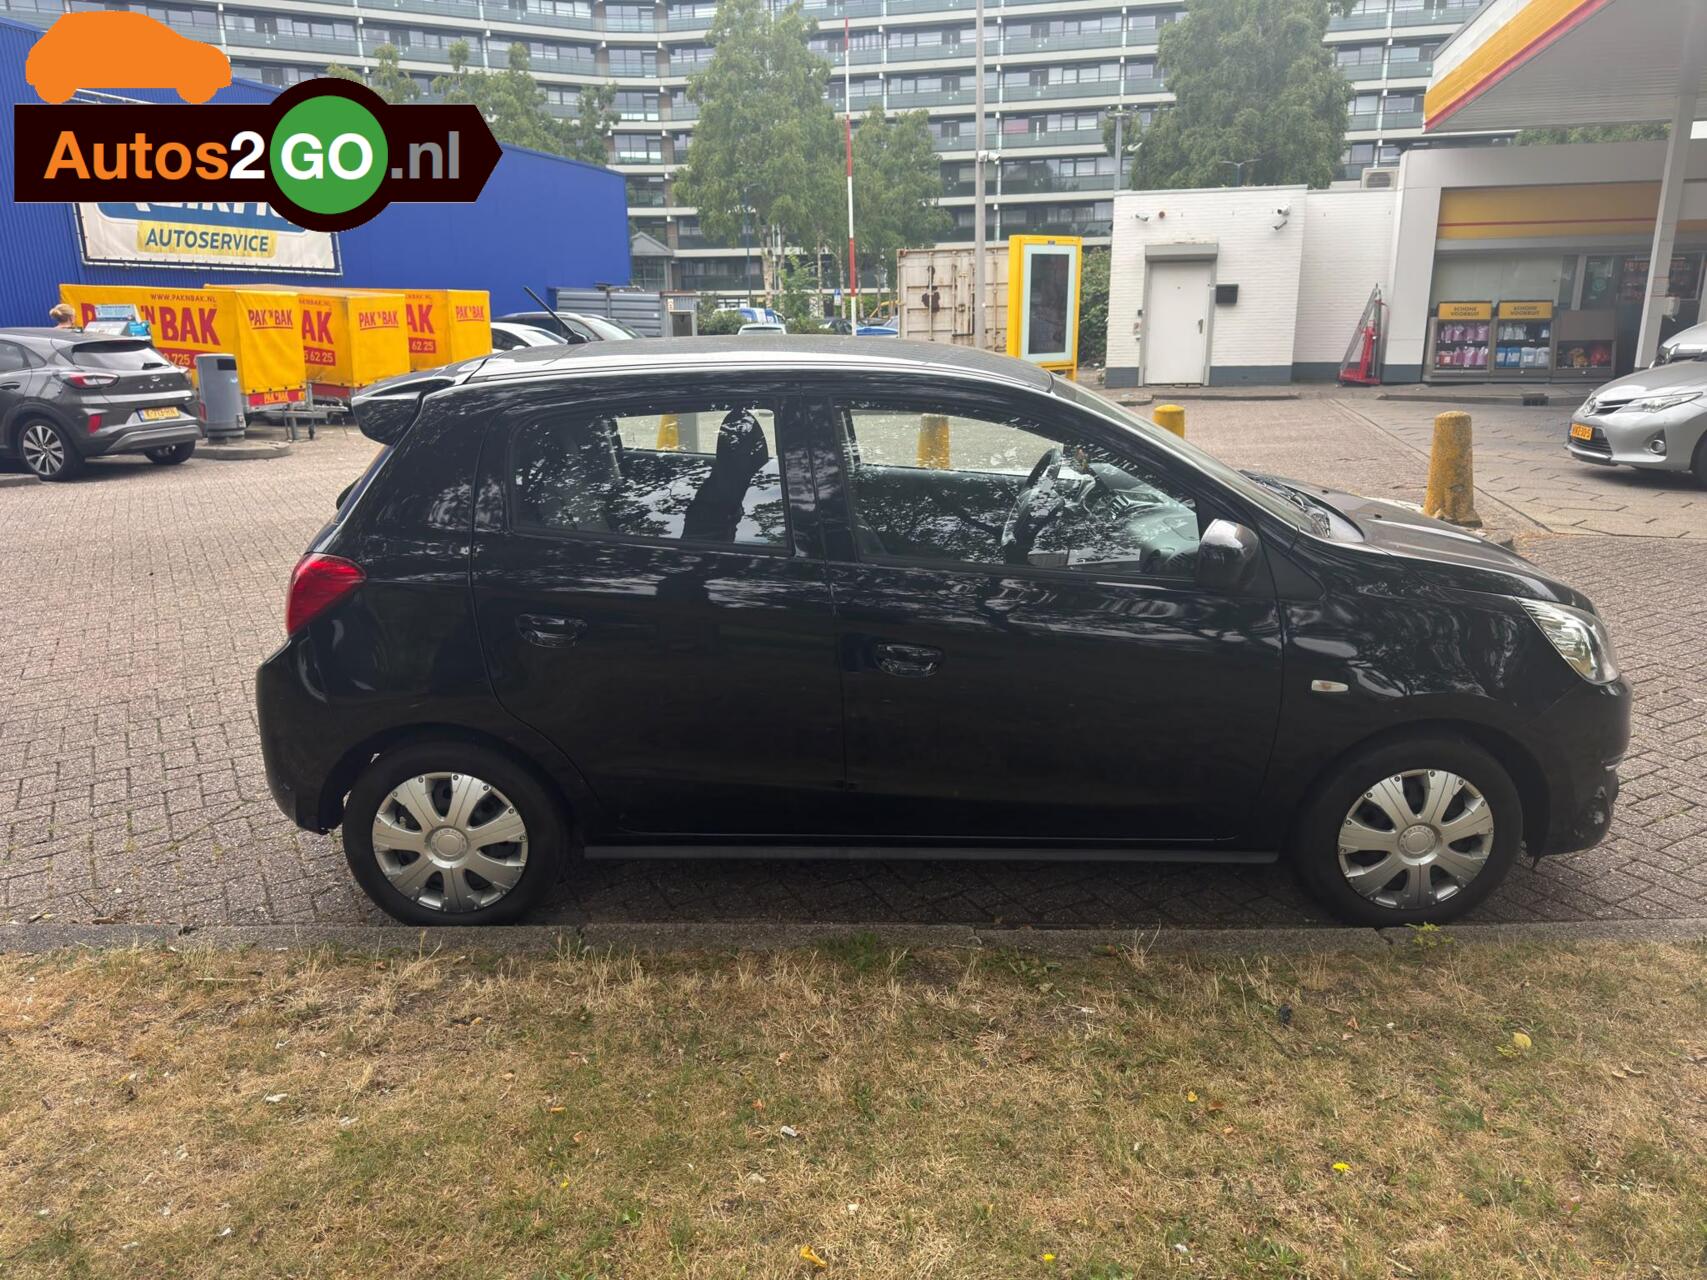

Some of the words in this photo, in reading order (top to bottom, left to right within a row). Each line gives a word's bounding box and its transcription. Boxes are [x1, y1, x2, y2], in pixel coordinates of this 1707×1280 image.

[145, 228, 269, 252] AUTOSERVICE
[159, 306, 221, 346] BAK
[248, 309, 268, 326] PAK
[274, 309, 293, 326] BAK
[359, 311, 376, 328] PAK
[382, 310, 399, 326] BAK
[405, 303, 435, 335] AK
[302, 310, 334, 345] AK
[411, 341, 422, 351] 62
[423, 342, 434, 352] 25
[171, 353, 191, 366] 725
[310, 351, 321, 362] 62
[321, 351, 334, 363] 25
